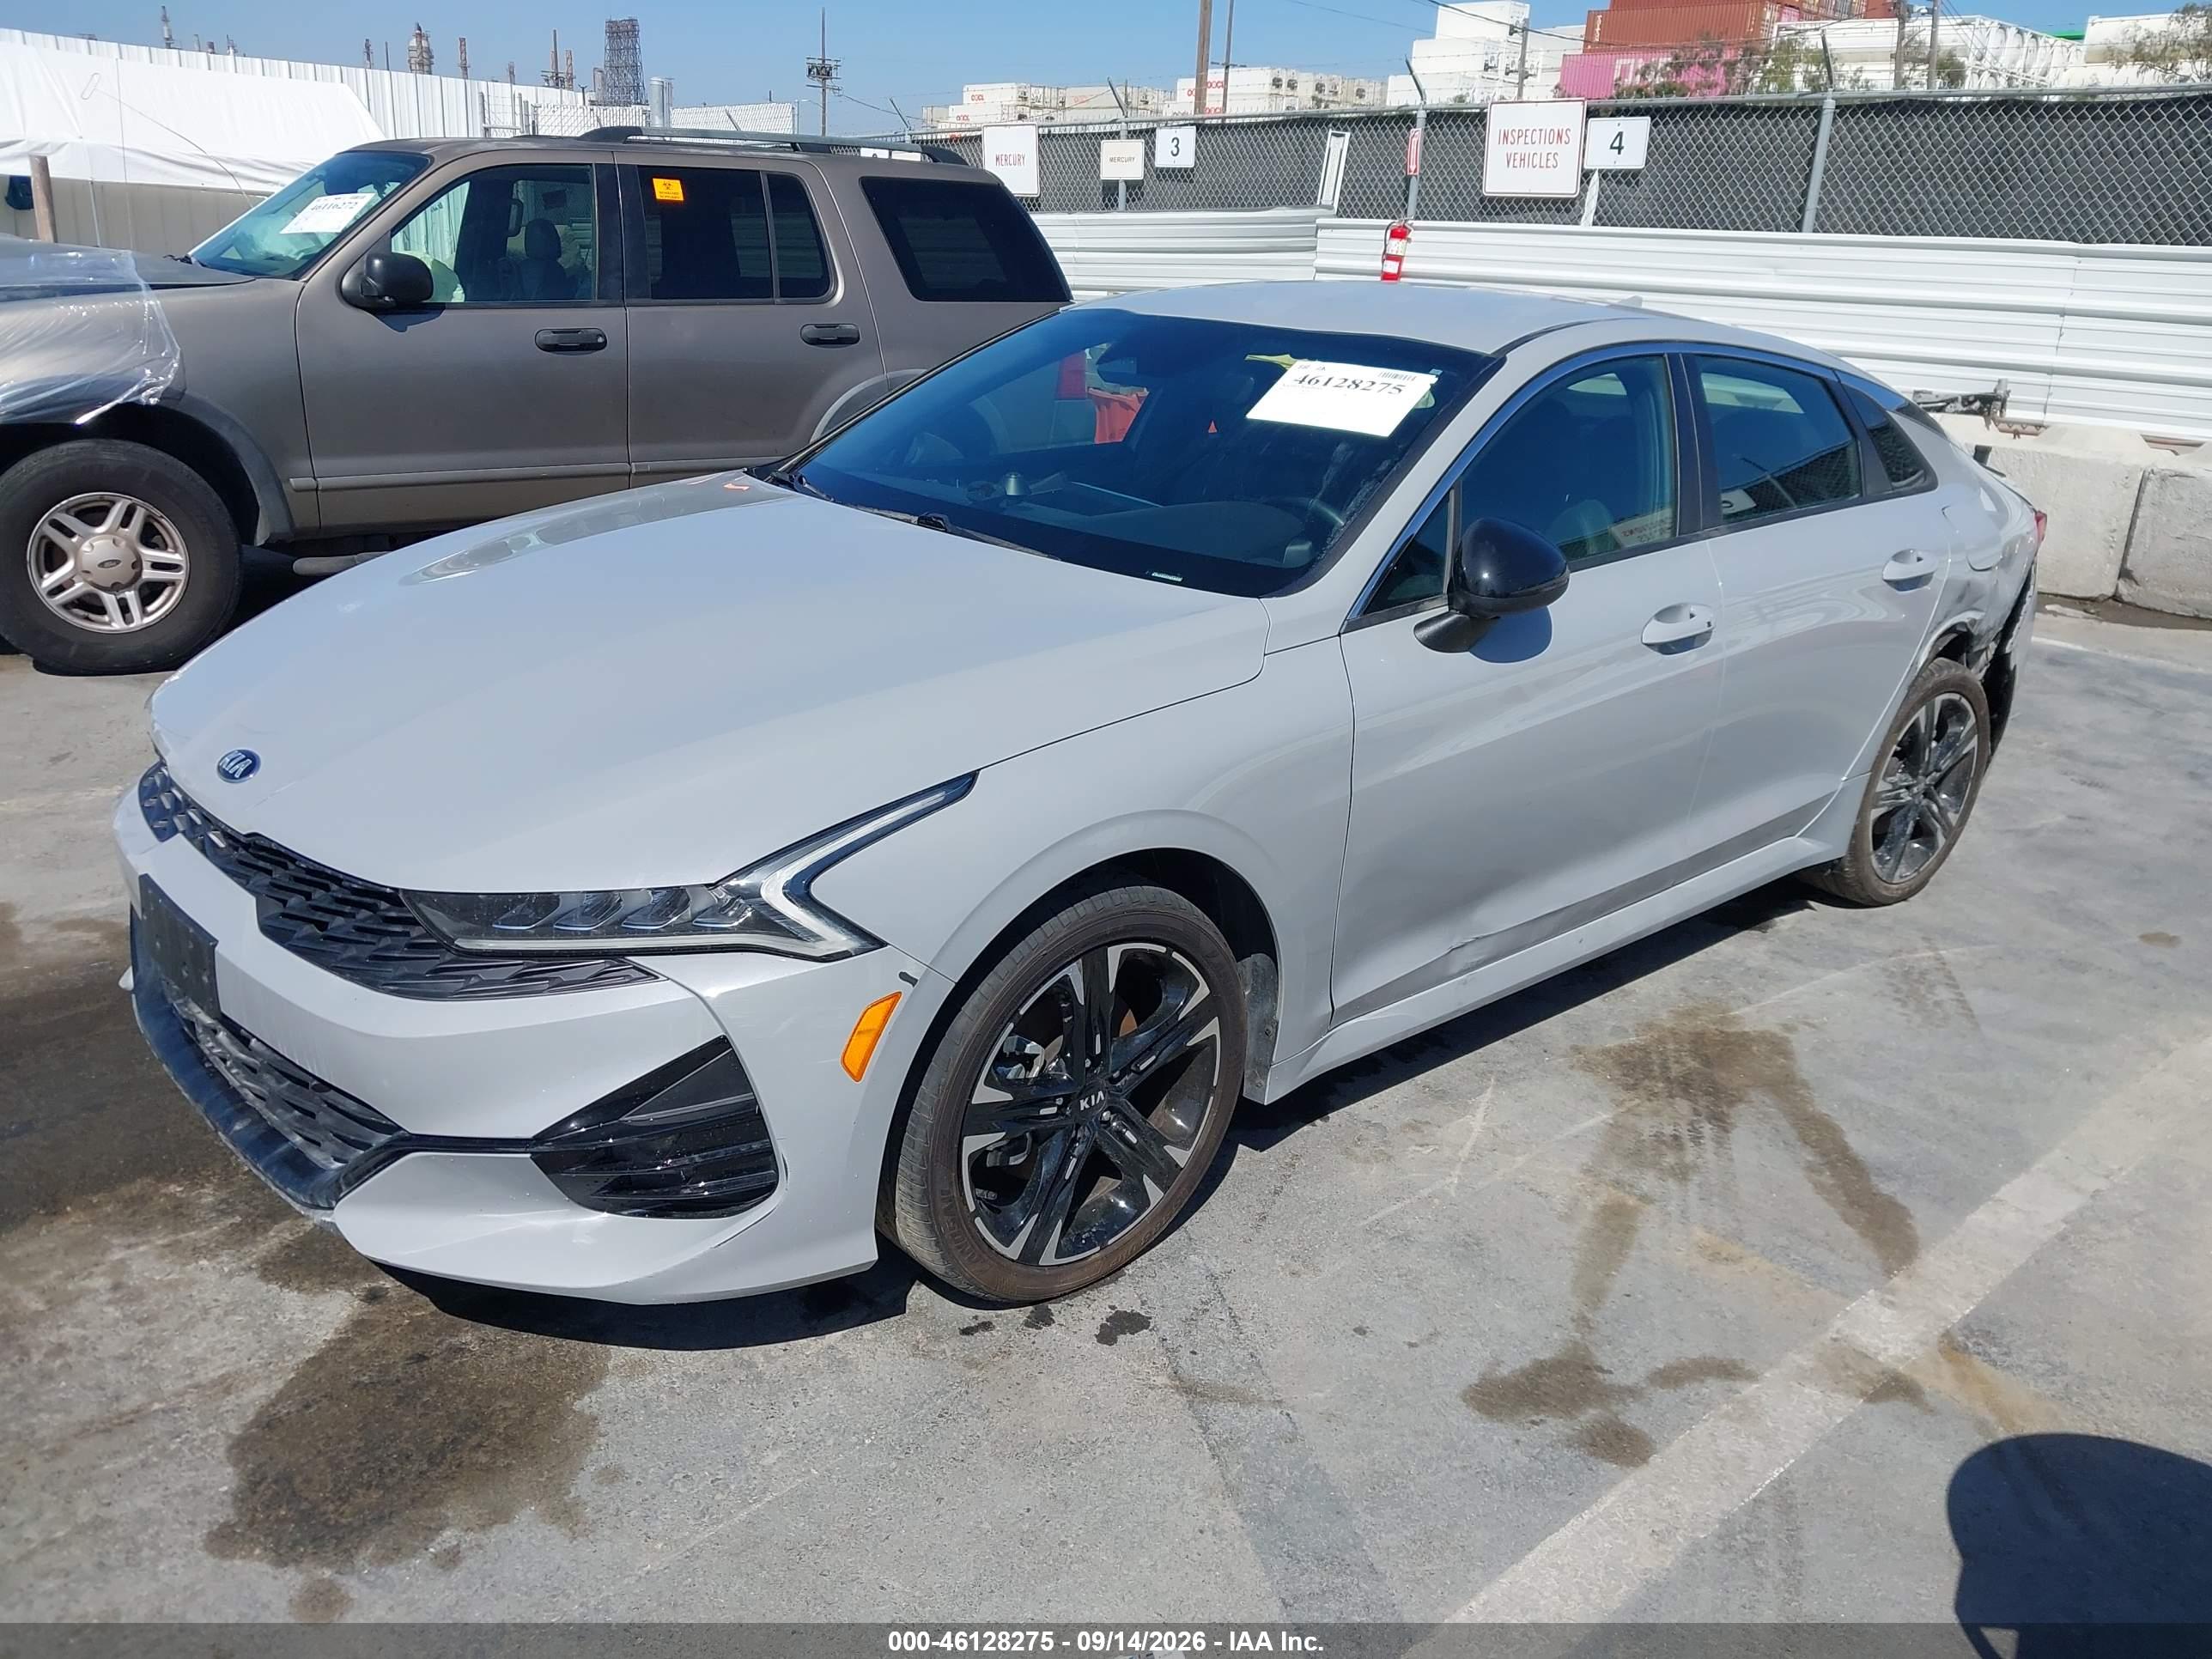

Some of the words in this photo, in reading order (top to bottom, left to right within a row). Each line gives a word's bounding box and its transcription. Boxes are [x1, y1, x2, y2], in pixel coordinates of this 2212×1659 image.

[1498, 128, 1571, 145] INSPECTIONS
[1609, 131, 1625, 155] 4
[1170, 137, 1181, 157] 3
[995, 153, 1026, 167] MERCURY
[1109, 155, 1136, 164] MERCURY
[1505, 151, 1559, 169] VEHICLES
[1293, 374, 1407, 395] 46128275
[1079, 1090, 1105, 1111] KIA
